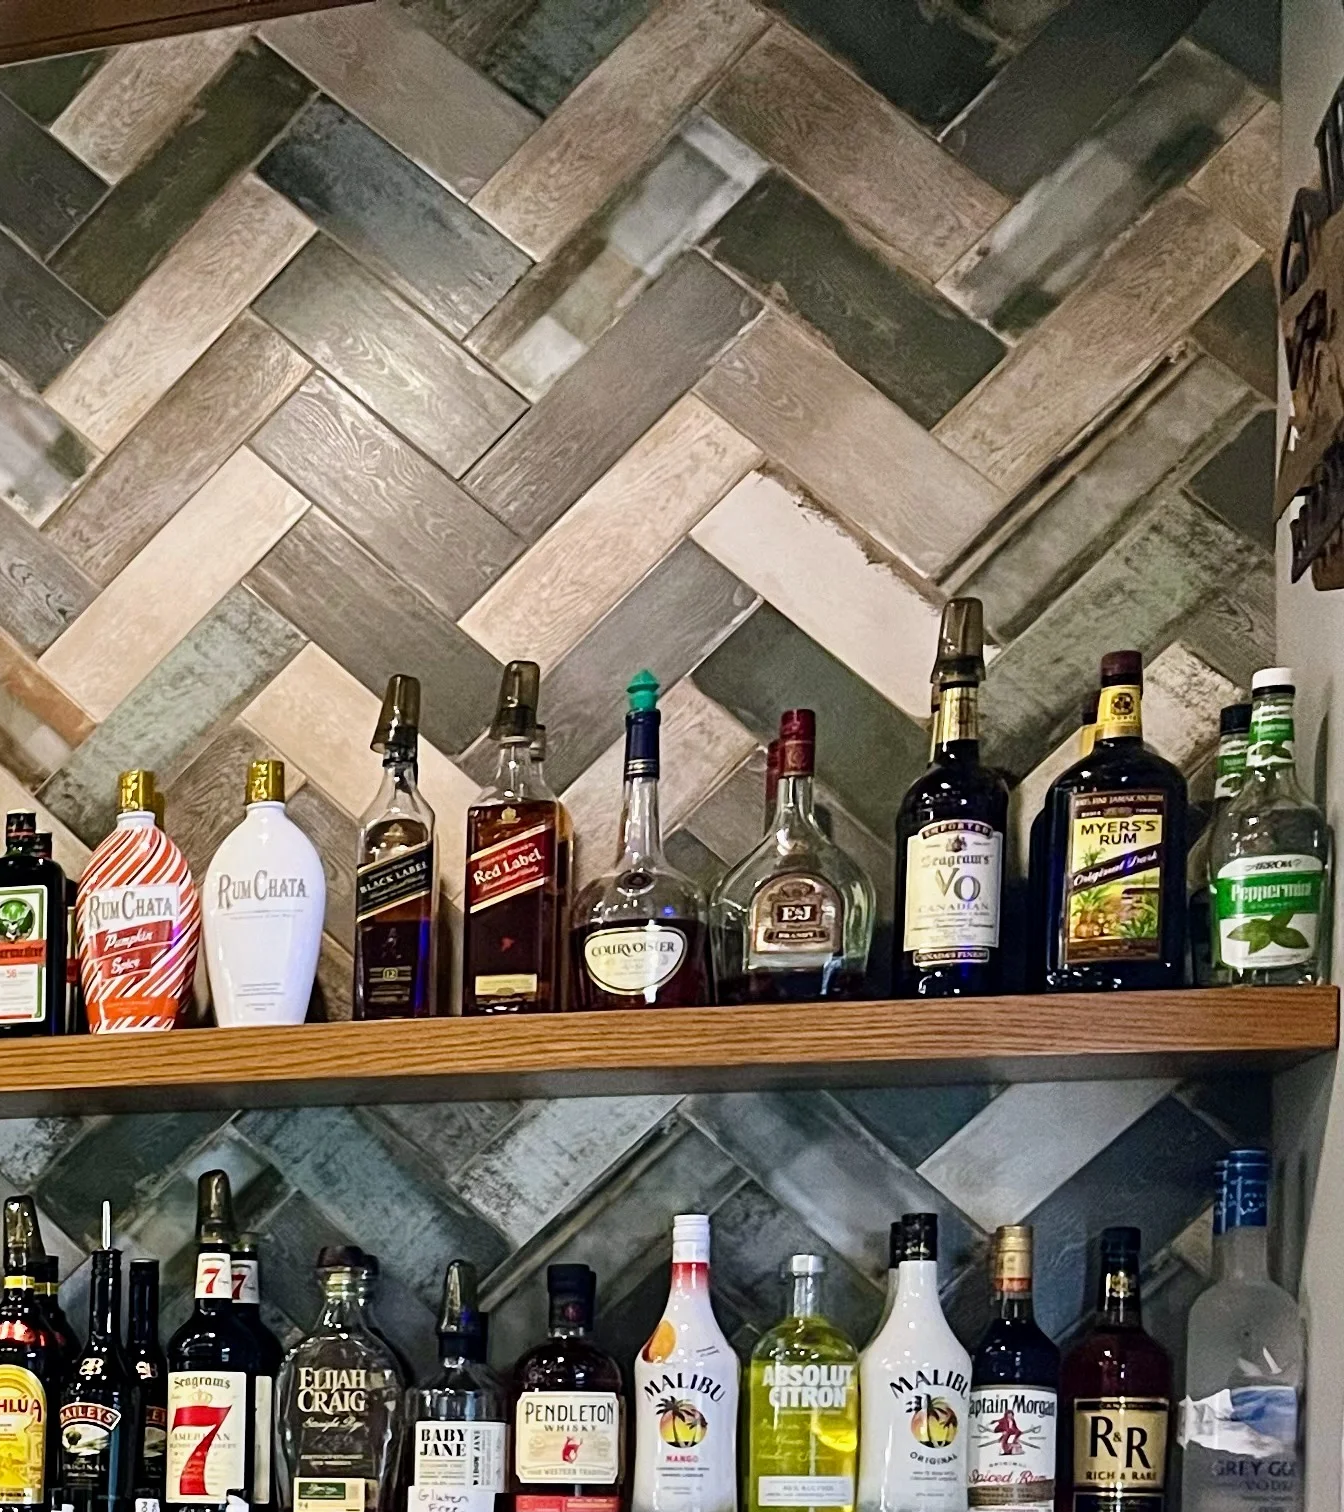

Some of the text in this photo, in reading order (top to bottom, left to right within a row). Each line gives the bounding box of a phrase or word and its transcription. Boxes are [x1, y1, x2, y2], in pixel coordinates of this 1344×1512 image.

[1100, 833, 1137, 845] RUM
[360, 861, 429, 893] BLACK LABEL
[473, 848, 543, 886] Red Label
[1074, 859, 1125, 886] Original
[936, 868, 981, 901] VO
[918, 904, 989, 912] CANADIAN
[299, 1368, 366, 1390] ELIJAH
[763, 1365, 854, 1386] ABSOLUT
[889, 1369, 968, 1400] MALIBU
[644, 1373, 727, 1404] MALIBU
[769, 1387, 847, 1408] CITRON
[297, 1390, 366, 1413] CRAIG
[60, 1405, 118, 1425] BAILEYS
[525, 1402, 614, 1424] PENDLETON
[420, 1429, 468, 1442] BABY
[544, 1424, 597, 1432] WHISKY
[172, 1405, 232, 1496] 7
[419, 1444, 467, 1457] JANE
[665, 1455, 700, 1463] MANGO
[909, 1451, 958, 1466] ORIGINAL
[968, 1471, 1013, 1485] Spiced
[1086, 1470, 1156, 1480] RICH RARE
[418, 1489, 469, 1503] Gluten
